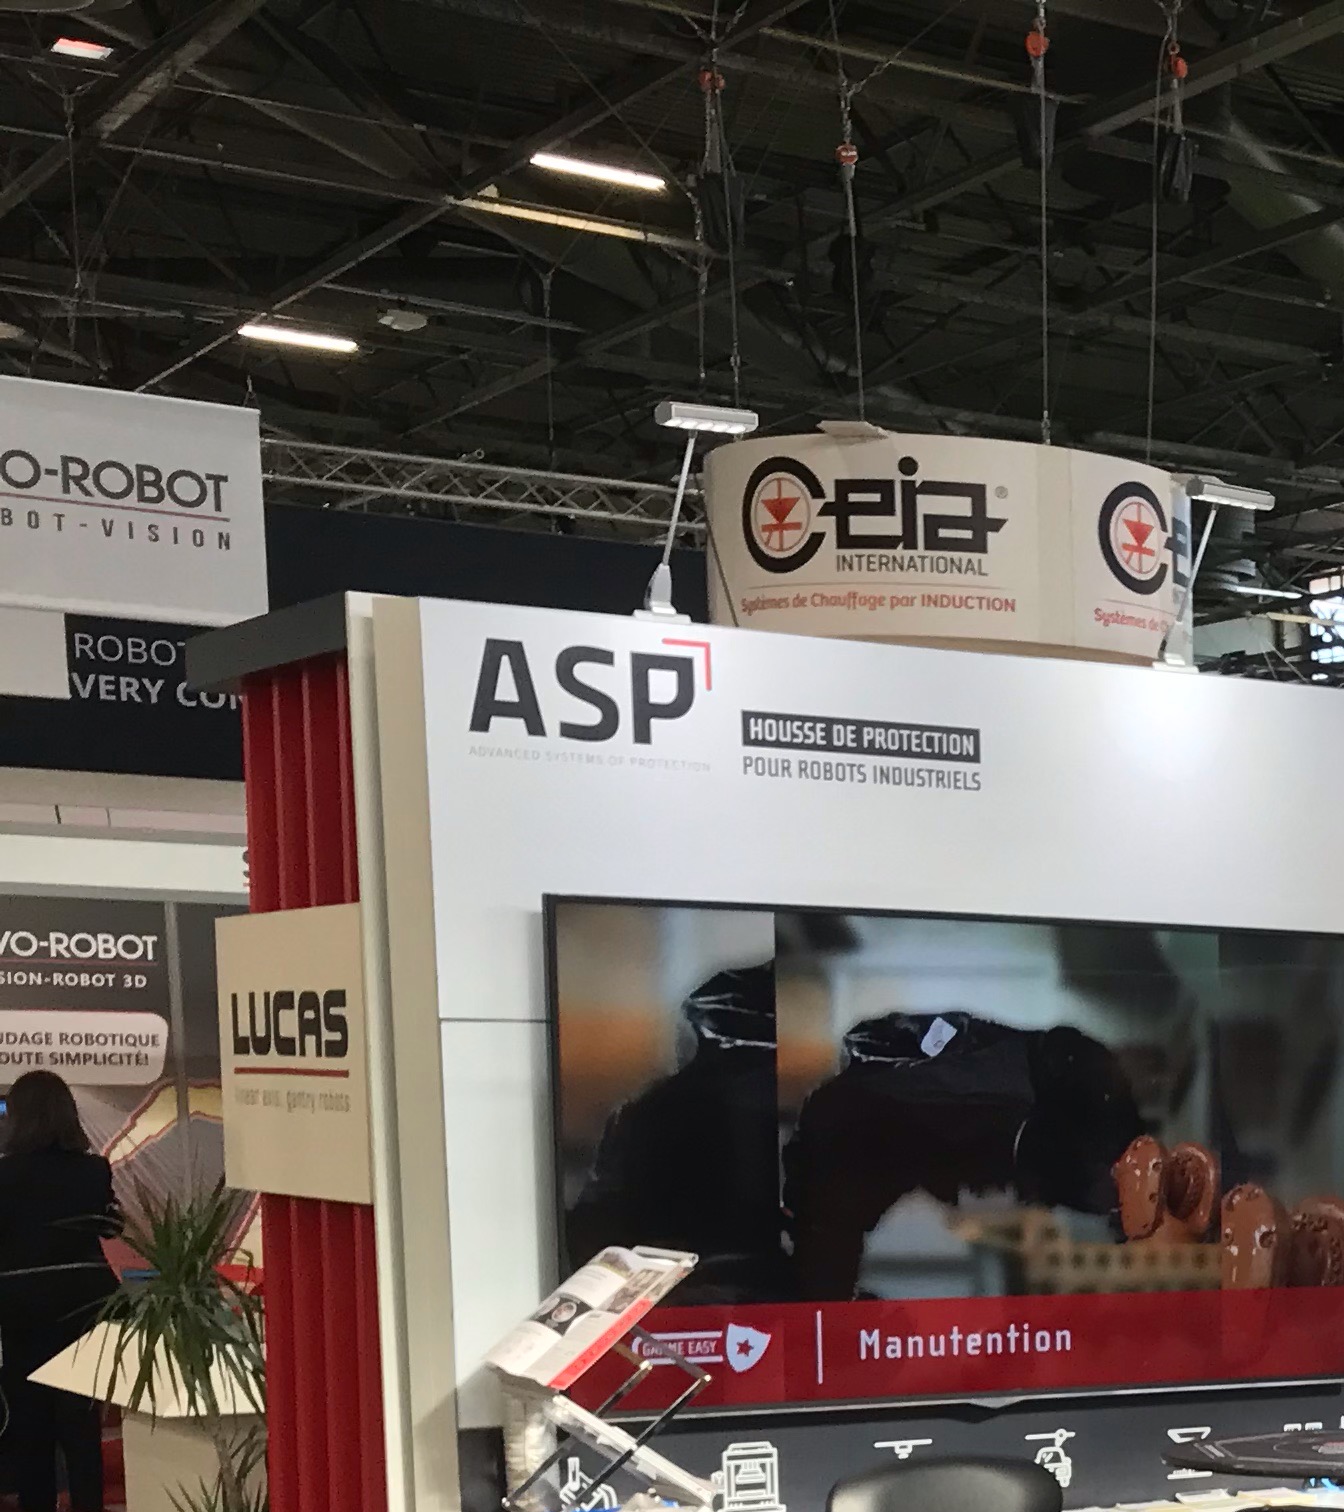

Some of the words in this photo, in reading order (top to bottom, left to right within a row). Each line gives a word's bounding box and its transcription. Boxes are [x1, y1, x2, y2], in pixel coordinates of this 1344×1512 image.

[0, 449, 228, 512] O-ROBOT
[1, 507, 230, 550] BOT-VISION
[836, 555, 989, 576] INTERNATIONAL
[792, 592, 807, 609] de
[811, 591, 885, 612] Chauffage
[890, 594, 916, 611] par
[920, 594, 1016, 613] INDUCTION
[71, 672, 164, 704] VERY
[469, 638, 695, 745] ASP
[749, 717, 827, 746] HOUSSE
[833, 723, 857, 747] DE
[862, 725, 975, 757] PROTECTION
[742, 756, 793, 780] POUR
[798, 760, 867, 784] ROBOTS
[872, 764, 982, 792] INDUSTRIELS
[123, 974, 147, 988] 3D
[59, 1032, 160, 1047] ROBOTIQUE
[231, 989, 349, 1058] LUCAS
[688, 1340, 717, 1354] EASY
[859, 1323, 1073, 1361] Manutention
